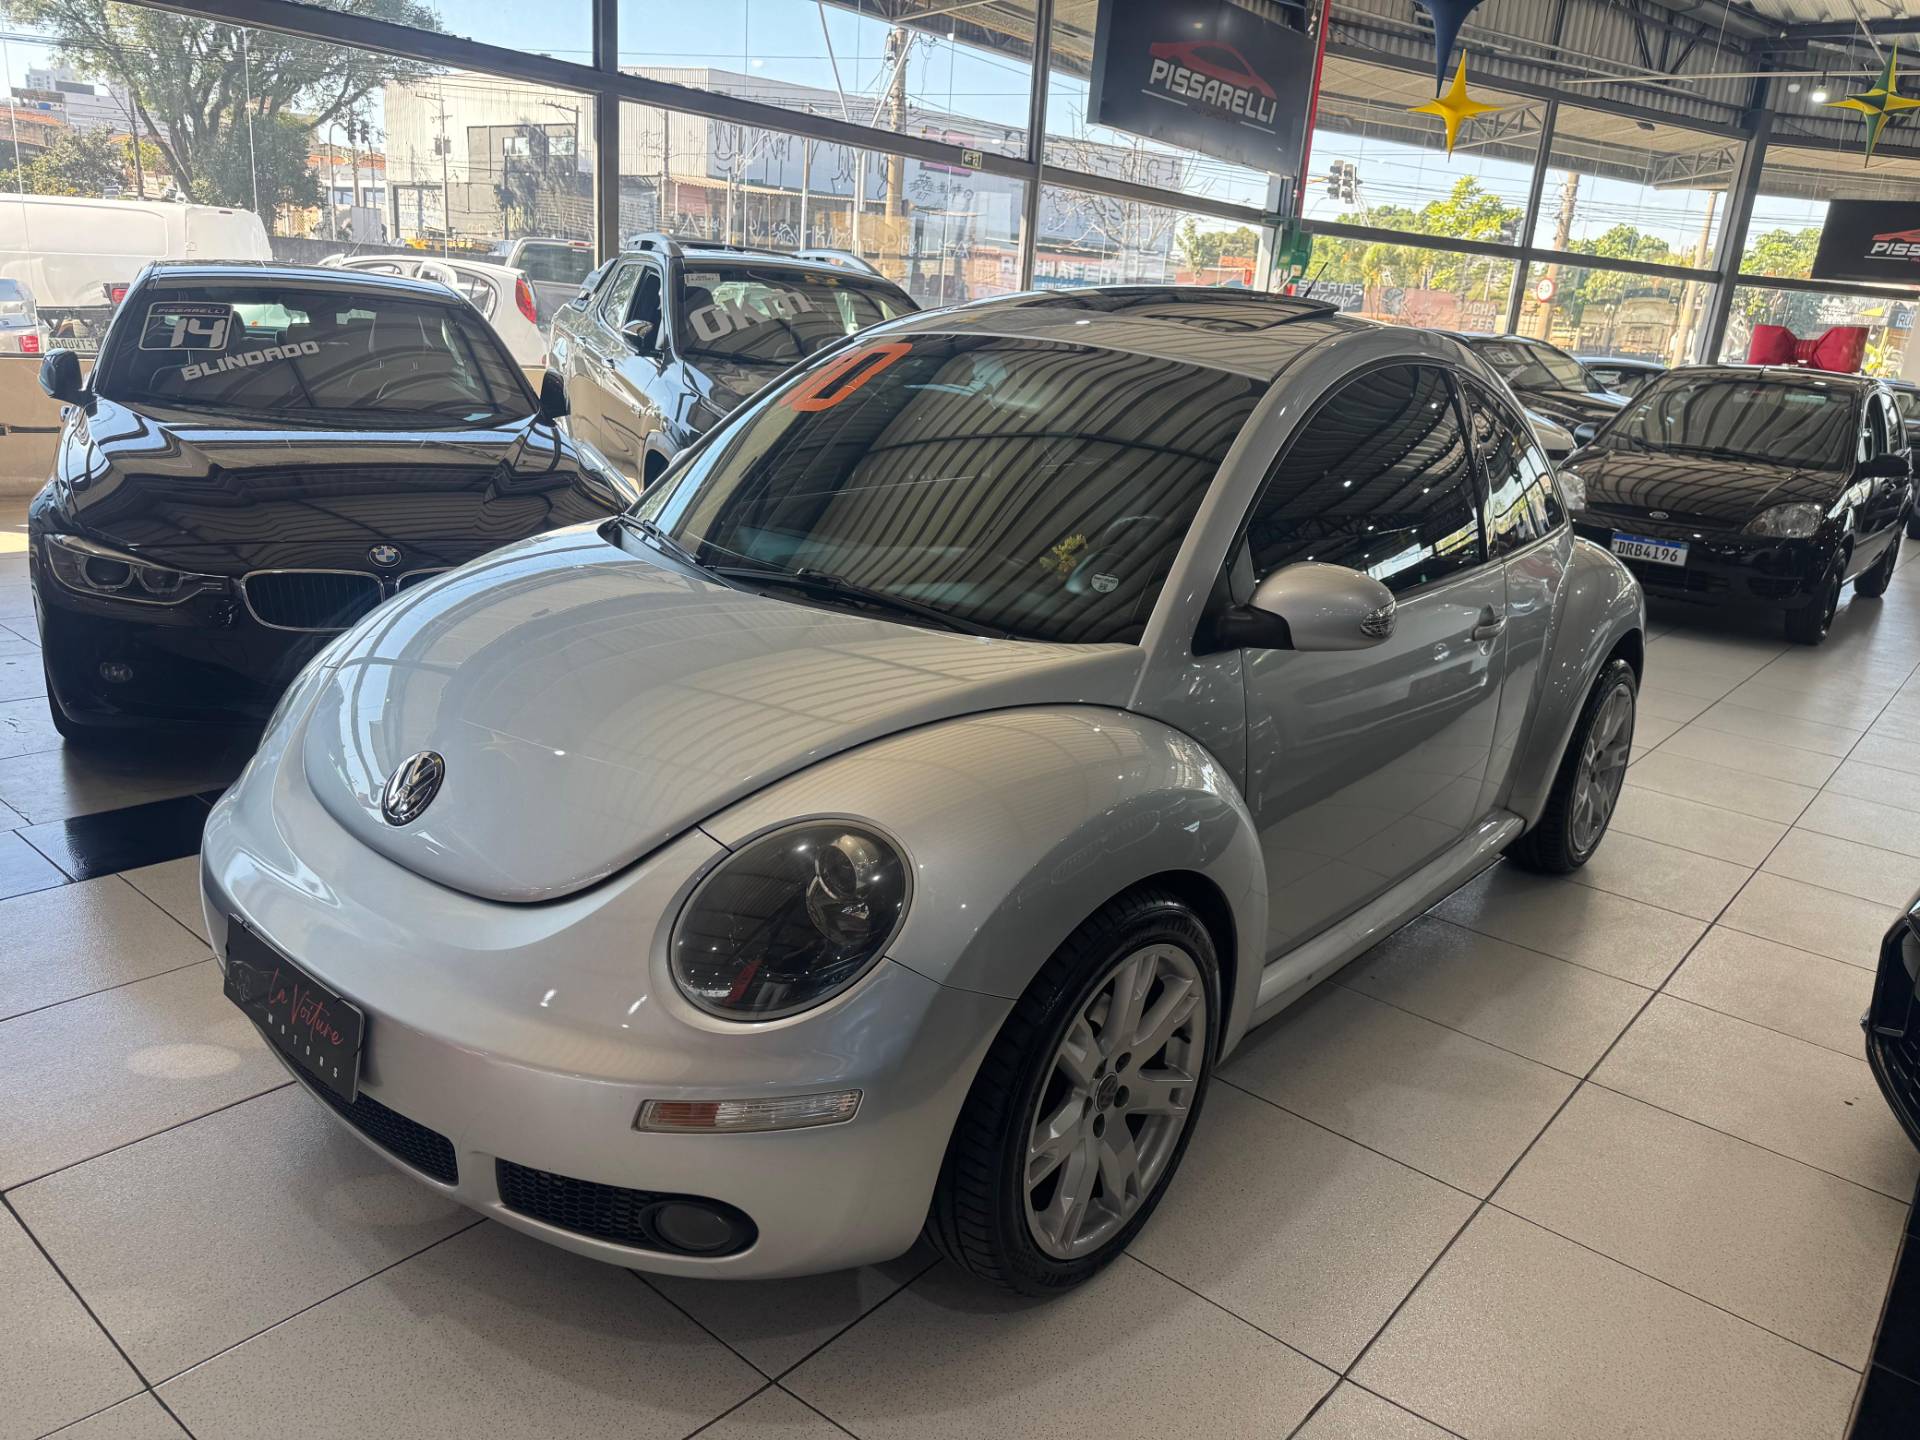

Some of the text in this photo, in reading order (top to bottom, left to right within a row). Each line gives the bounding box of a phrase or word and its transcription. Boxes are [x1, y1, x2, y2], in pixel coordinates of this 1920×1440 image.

[1149, 59, 1277, 124] PISSARELLI
[170, 317, 226, 348] 14
[180, 340, 320, 381] BLINDADO
[269, 967, 344, 1046] La Voiture
[267, 1011, 339, 1078] MOTORS
